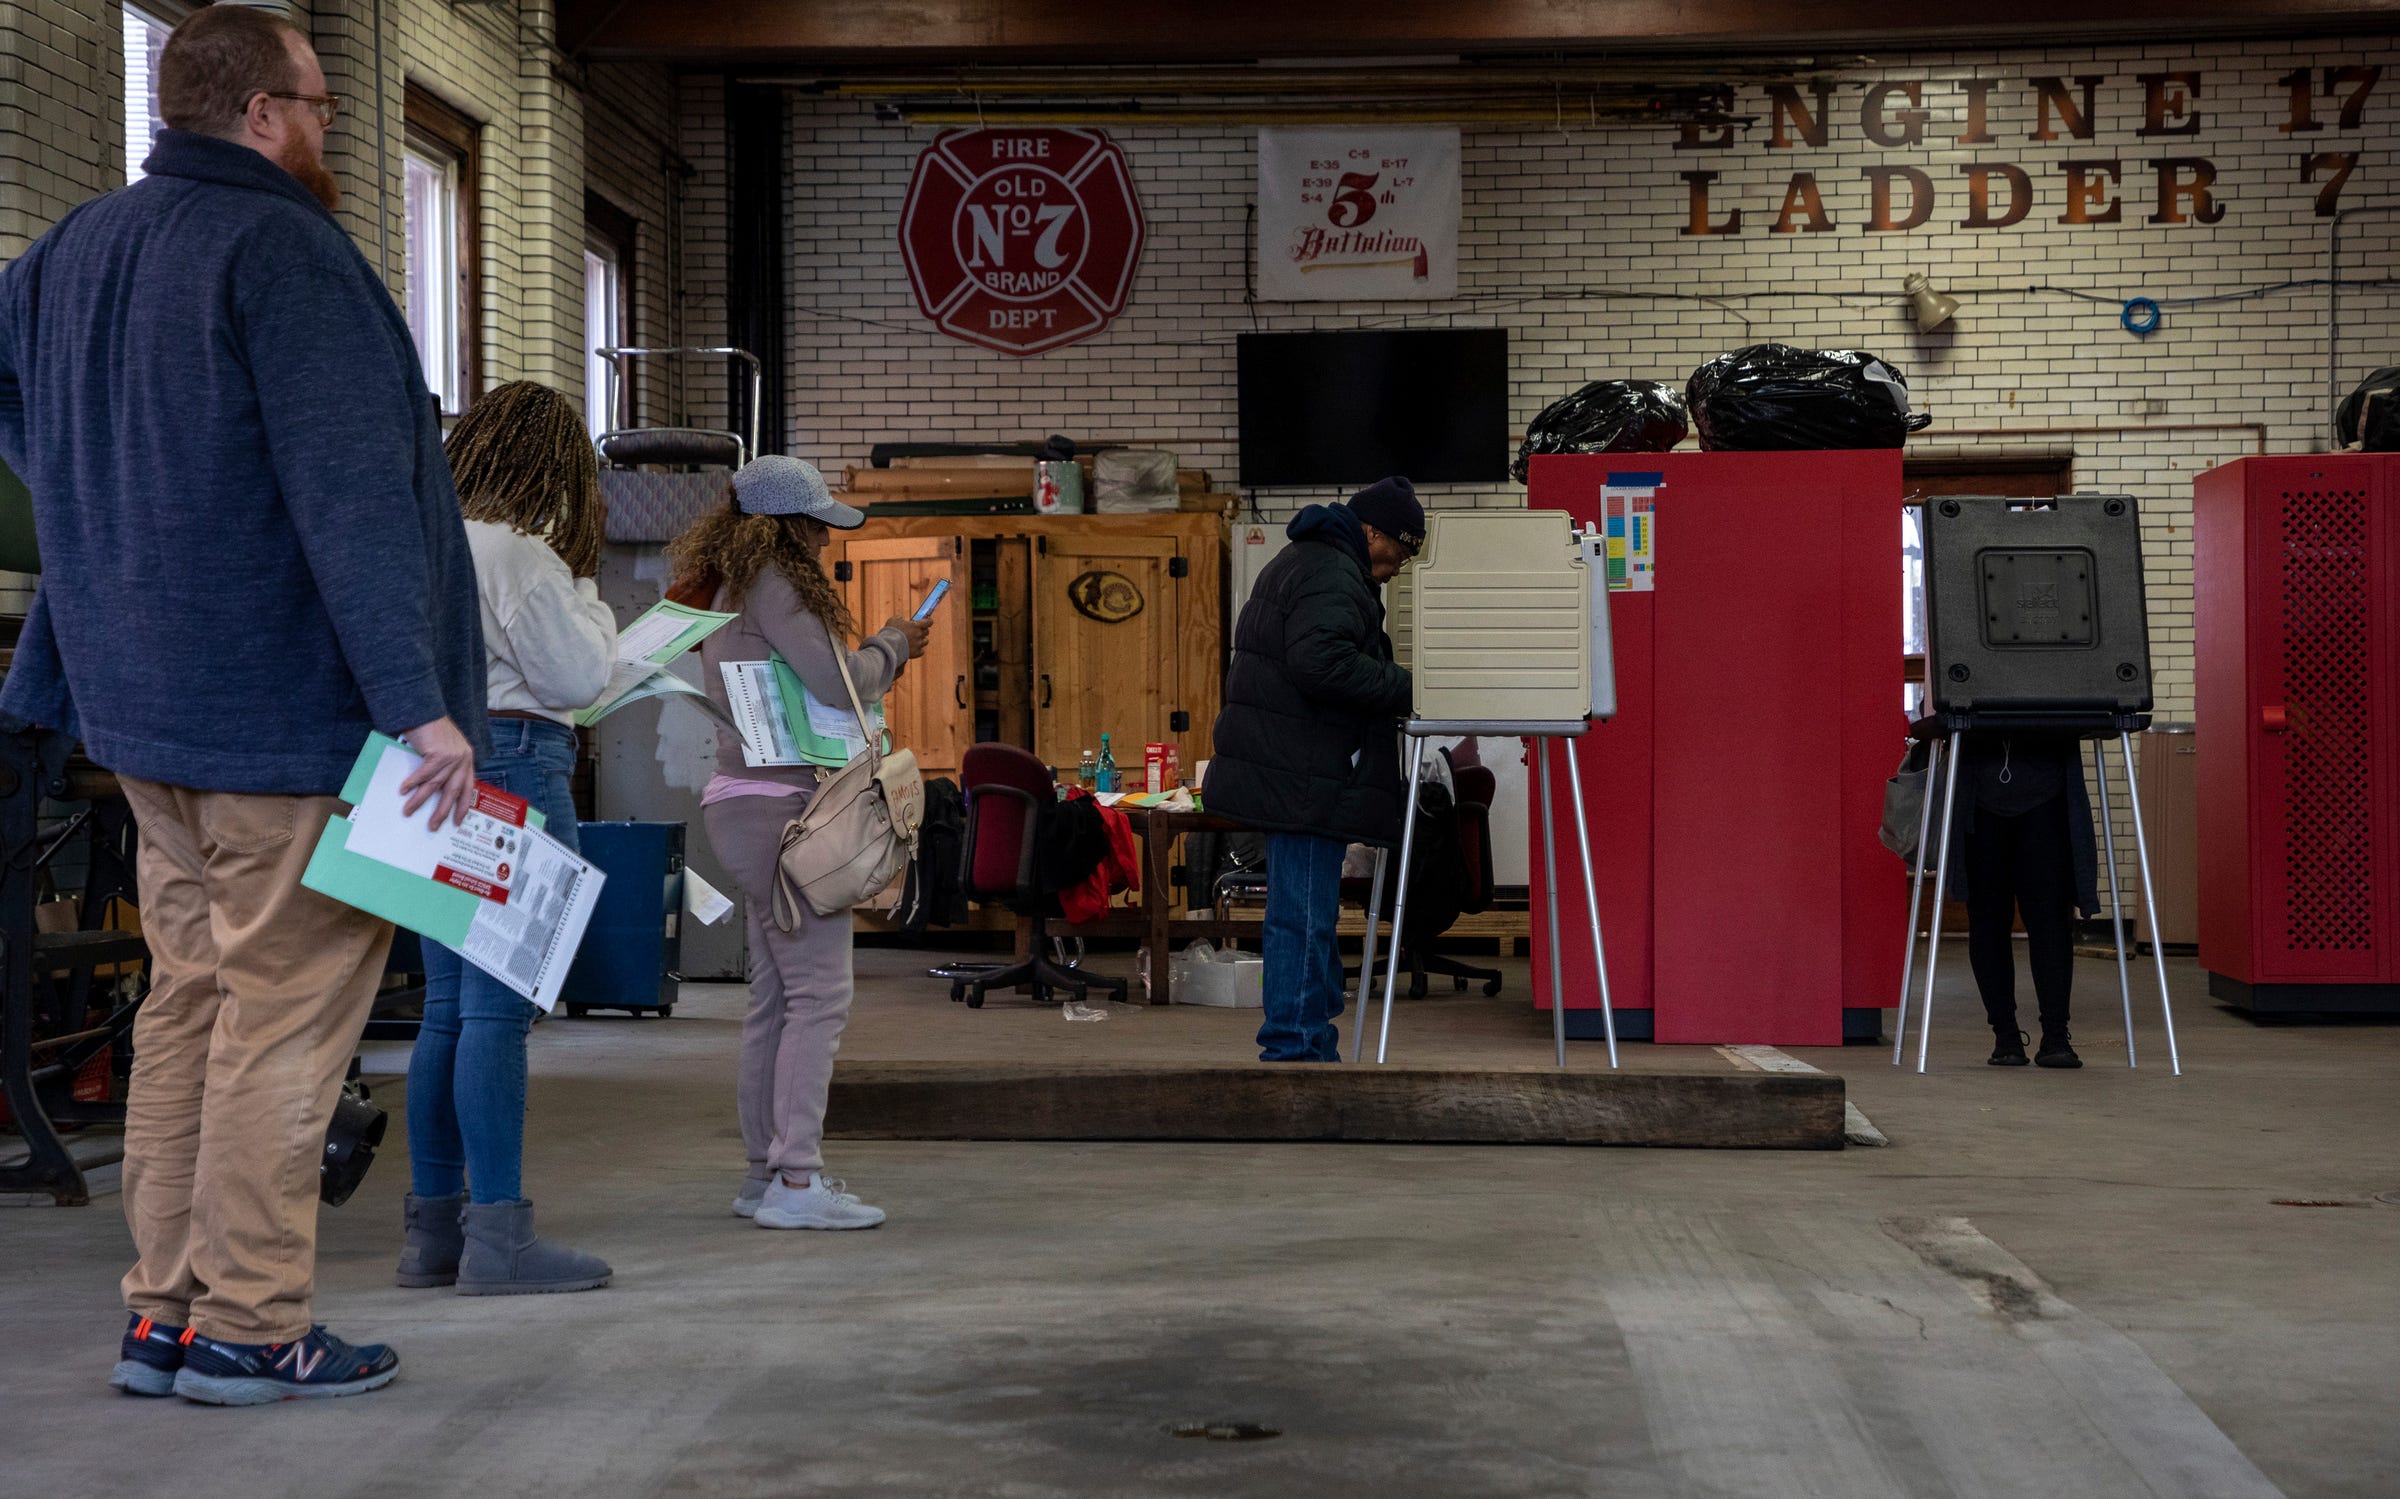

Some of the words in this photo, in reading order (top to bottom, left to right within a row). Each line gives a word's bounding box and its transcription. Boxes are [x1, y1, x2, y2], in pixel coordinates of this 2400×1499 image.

[1672, 72, 2200, 149] ENGINE
[2278, 65, 2382, 133] 17
[992, 138, 1050, 158] FIRE
[1381, 159, 1408, 169] E-17
[994, 175, 1046, 197] OLD
[1393, 177, 1414, 187] L-7
[1680, 157, 2226, 235] LADDER
[2300, 152, 2360, 217] 7
[1034, 202, 1077, 268] 7
[1290, 225, 1419, 262] Battalion
[985, 271, 1060, 294] BRAND
[989, 309, 1057, 328] DEPT
